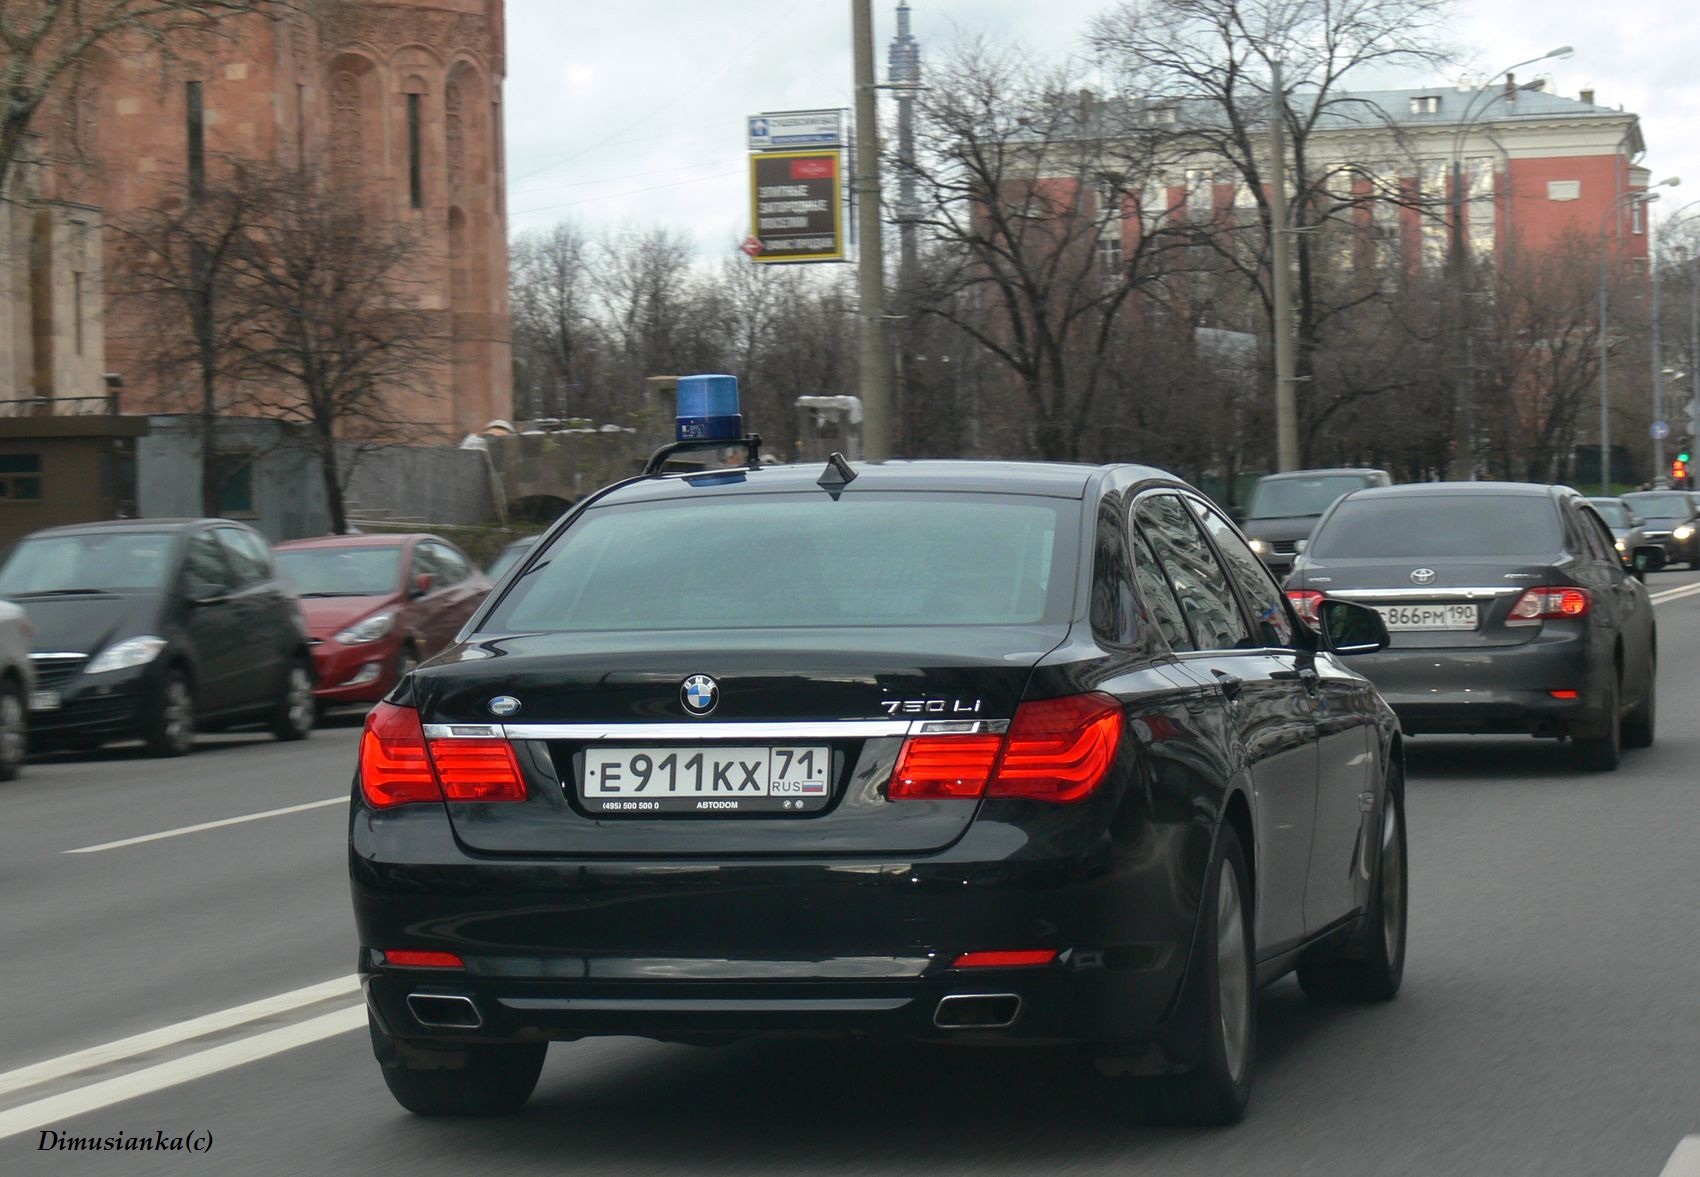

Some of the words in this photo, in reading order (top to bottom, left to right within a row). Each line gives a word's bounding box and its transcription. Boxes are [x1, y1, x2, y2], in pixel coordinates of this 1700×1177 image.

[1448, 606, 1473, 619] 190
[880, 699, 947, 713] 750
[775, 750, 813, 779] 71
[772, 781, 800, 792] RUS
[623, 801, 637, 810] 500
